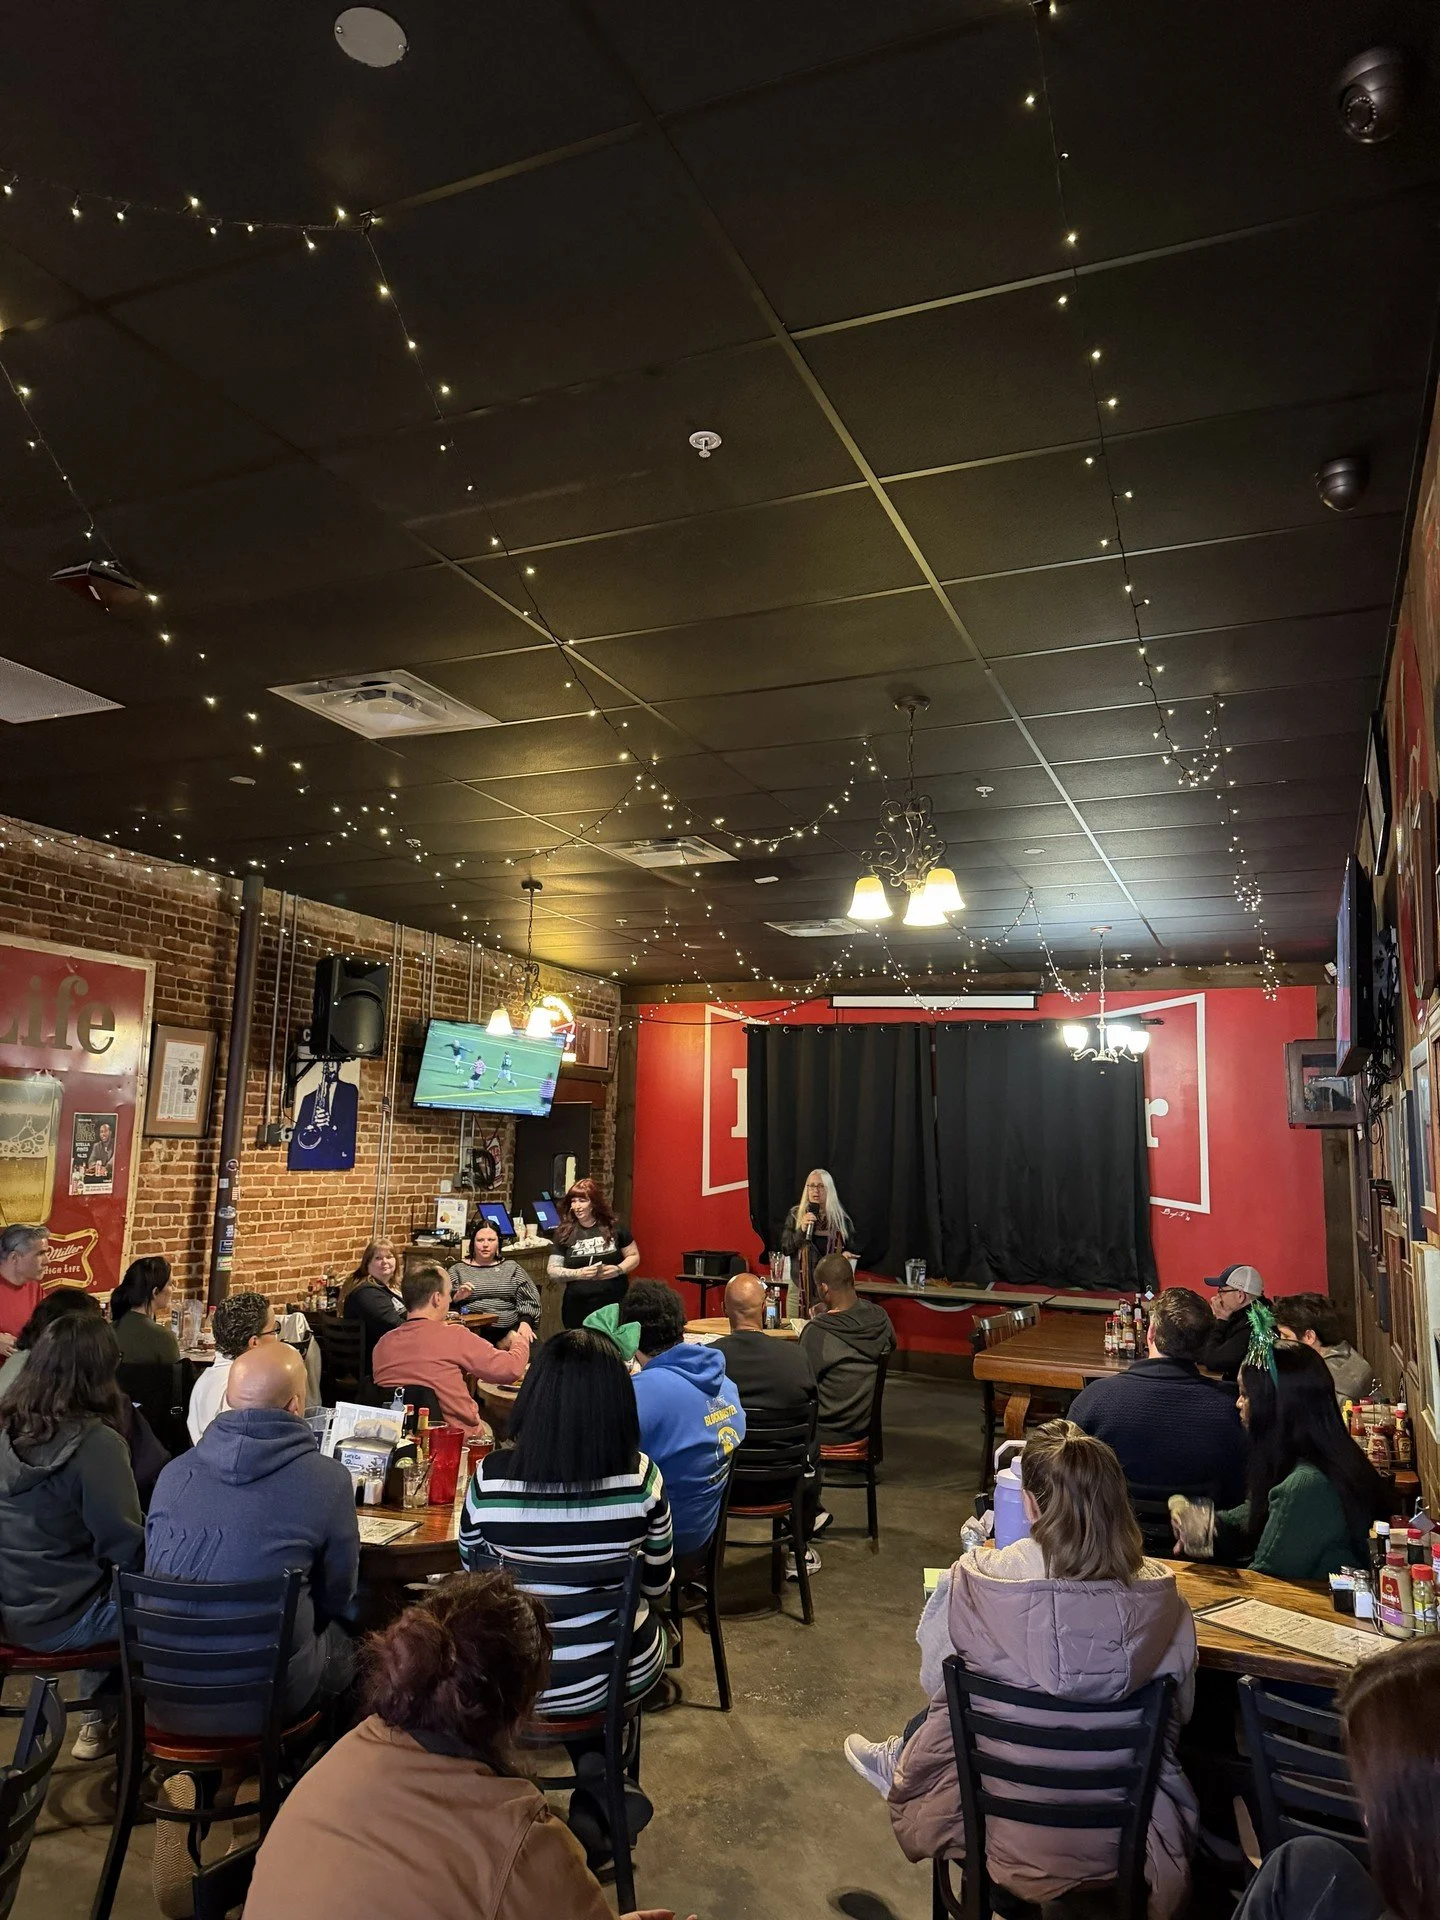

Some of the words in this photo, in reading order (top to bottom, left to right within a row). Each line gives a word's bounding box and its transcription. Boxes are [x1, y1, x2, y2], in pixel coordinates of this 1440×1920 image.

[46, 1244, 84, 1262] Miller
[63, 1264, 80, 1273] LIFE
[704, 1404, 738, 1427] BLOCKBUSTER
